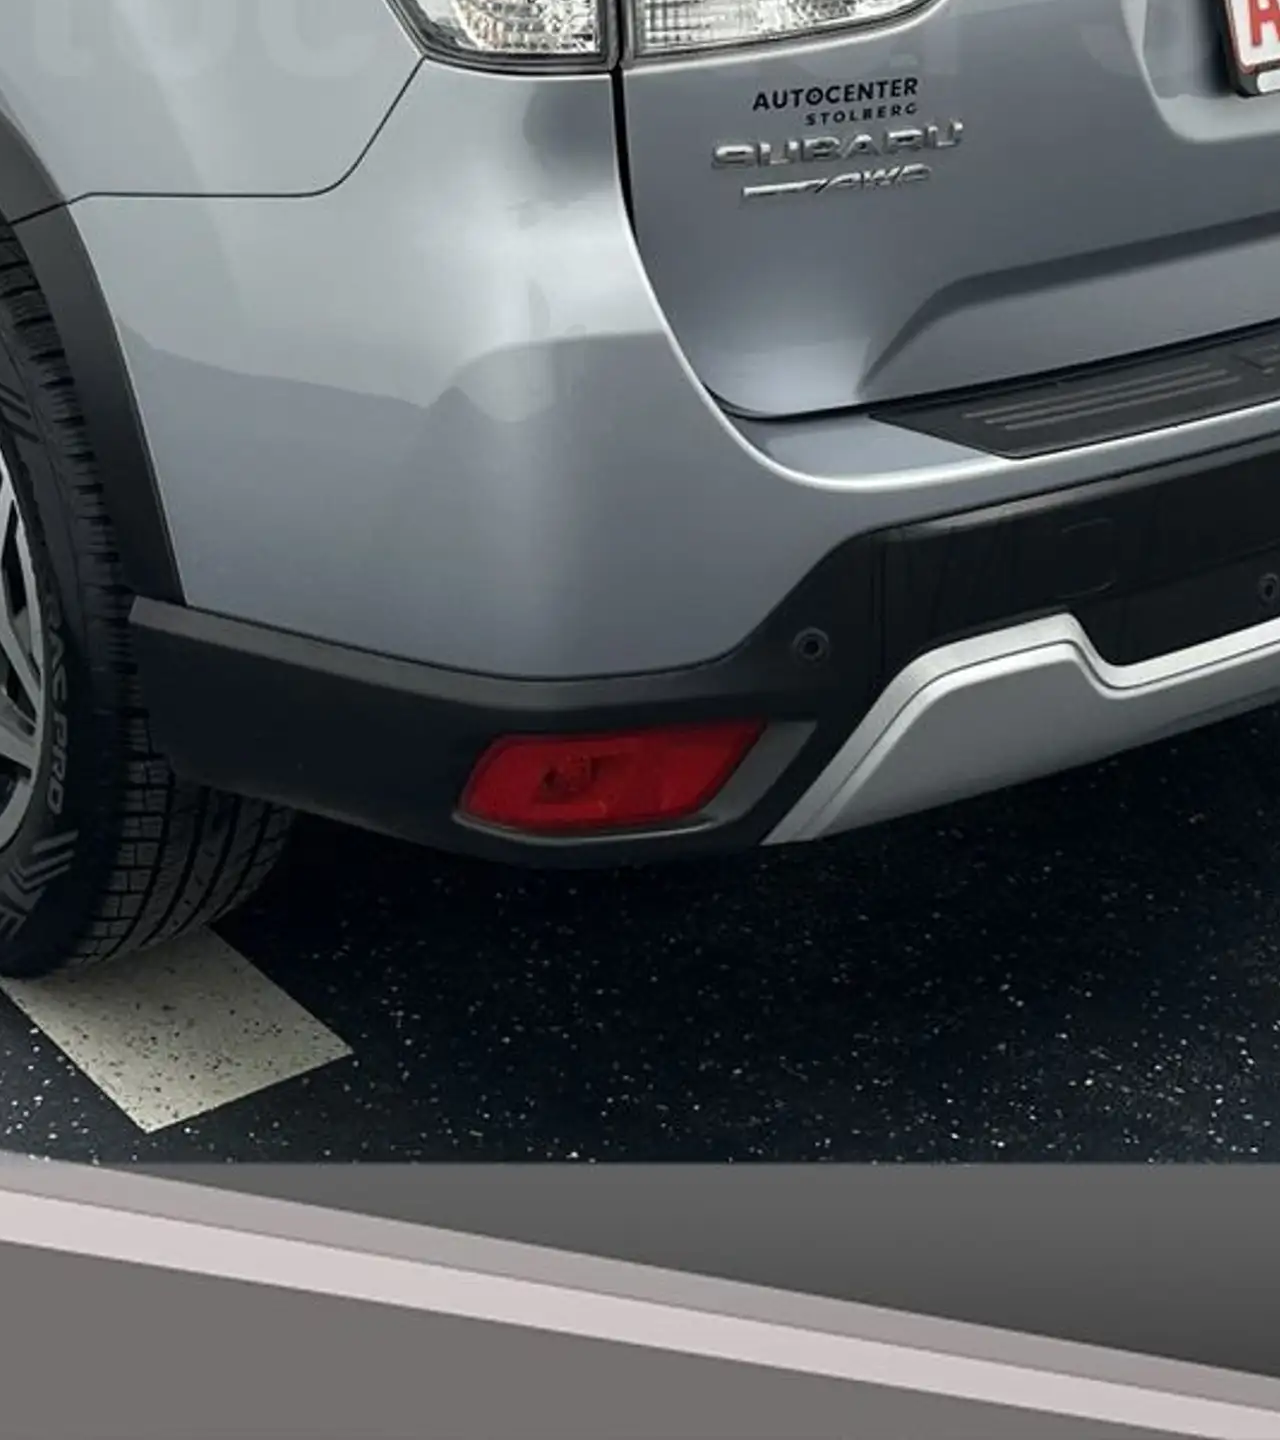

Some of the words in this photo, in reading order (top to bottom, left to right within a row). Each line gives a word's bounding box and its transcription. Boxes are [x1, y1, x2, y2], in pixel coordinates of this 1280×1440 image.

[752, 76, 919, 111] AUTOCENTER
[805, 102, 919, 126] STOLBERG
[711, 120, 964, 168] SUBARU
